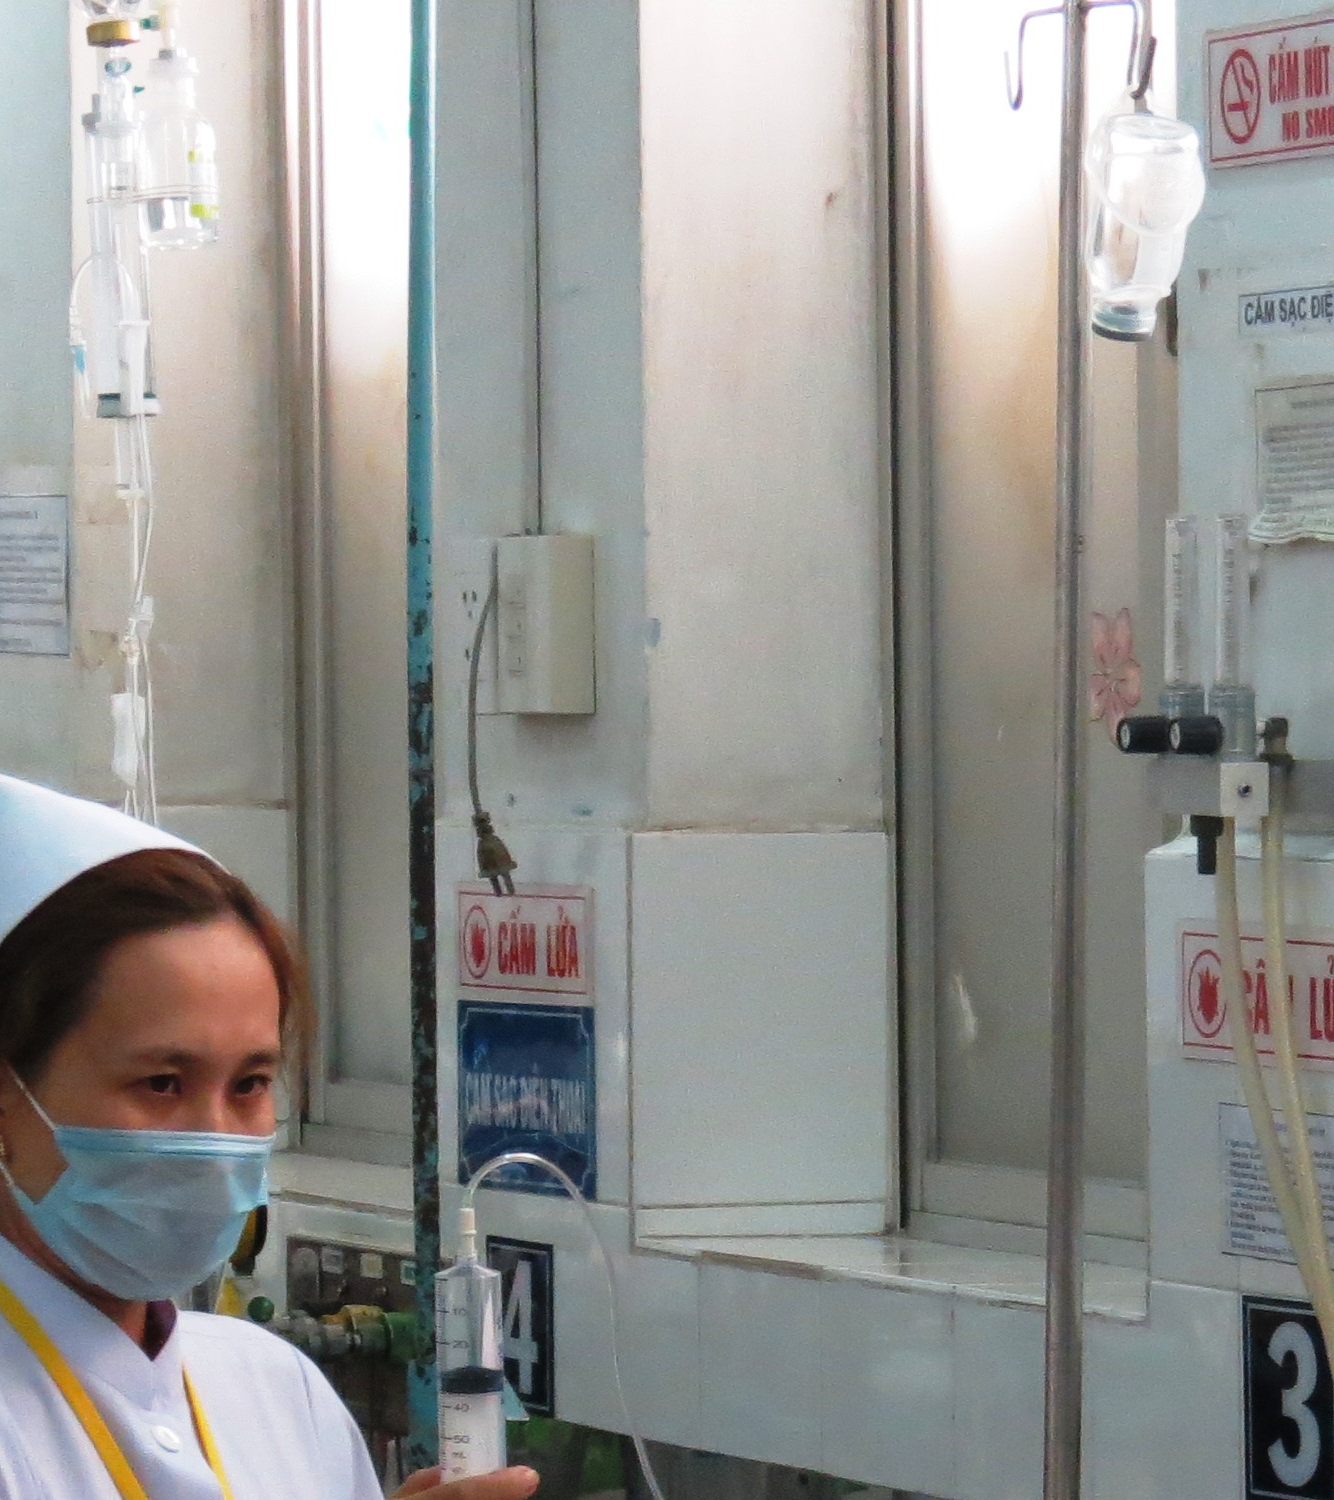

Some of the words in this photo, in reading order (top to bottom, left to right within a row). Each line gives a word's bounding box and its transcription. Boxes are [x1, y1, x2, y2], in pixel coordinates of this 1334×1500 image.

[1281, 111, 1300, 141] NO
[1279, 297, 1307, 327] SẠC
[502, 1260, 539, 1395] 4
[1268, 1321, 1321, 1487] 3
